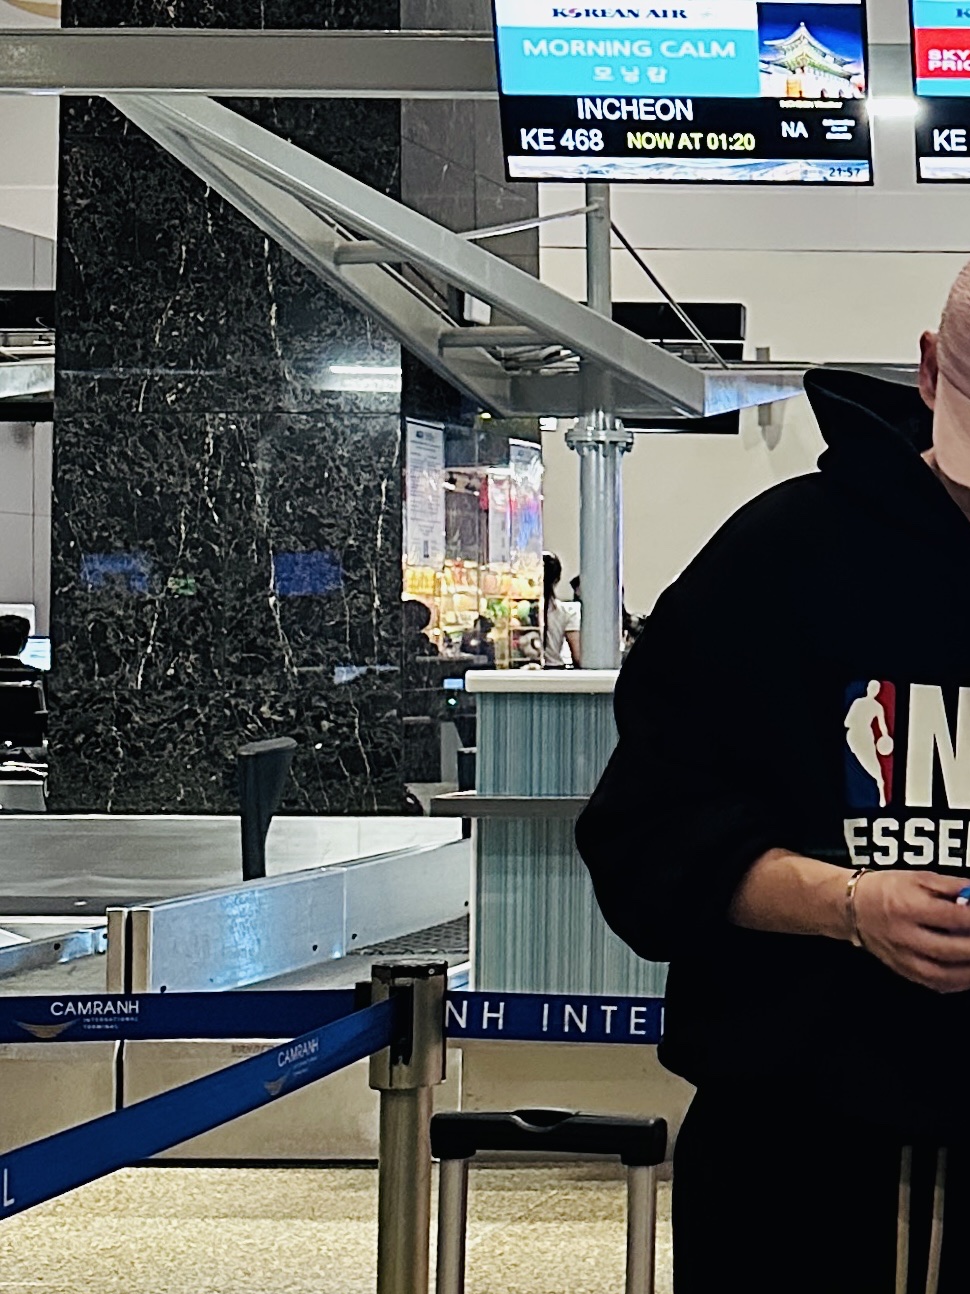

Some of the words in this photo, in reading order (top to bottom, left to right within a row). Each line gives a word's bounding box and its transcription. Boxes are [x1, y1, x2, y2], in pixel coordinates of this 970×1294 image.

[552, 8, 639, 19] KOREAN
[647, 9, 688, 19] AIR
[523, 39, 651, 58] MORNING
[660, 40, 736, 59] CALM
[928, 49, 970, 61] SKY
[577, 97, 694, 121] INCHEON
[781, 121, 808, 138] NA
[520, 128, 555, 151] KE
[560, 128, 604, 152] 468
[627, 132, 675, 150] NOW
[678, 132, 702, 150] AT
[706, 132, 755, 152] 01:20
[933, 129, 967, 152] KE
[51, 1000, 140, 1016] CAMRANH
[542, 1003, 664, 1037] INTE
[277, 1037, 319, 1068] CAMRANH
